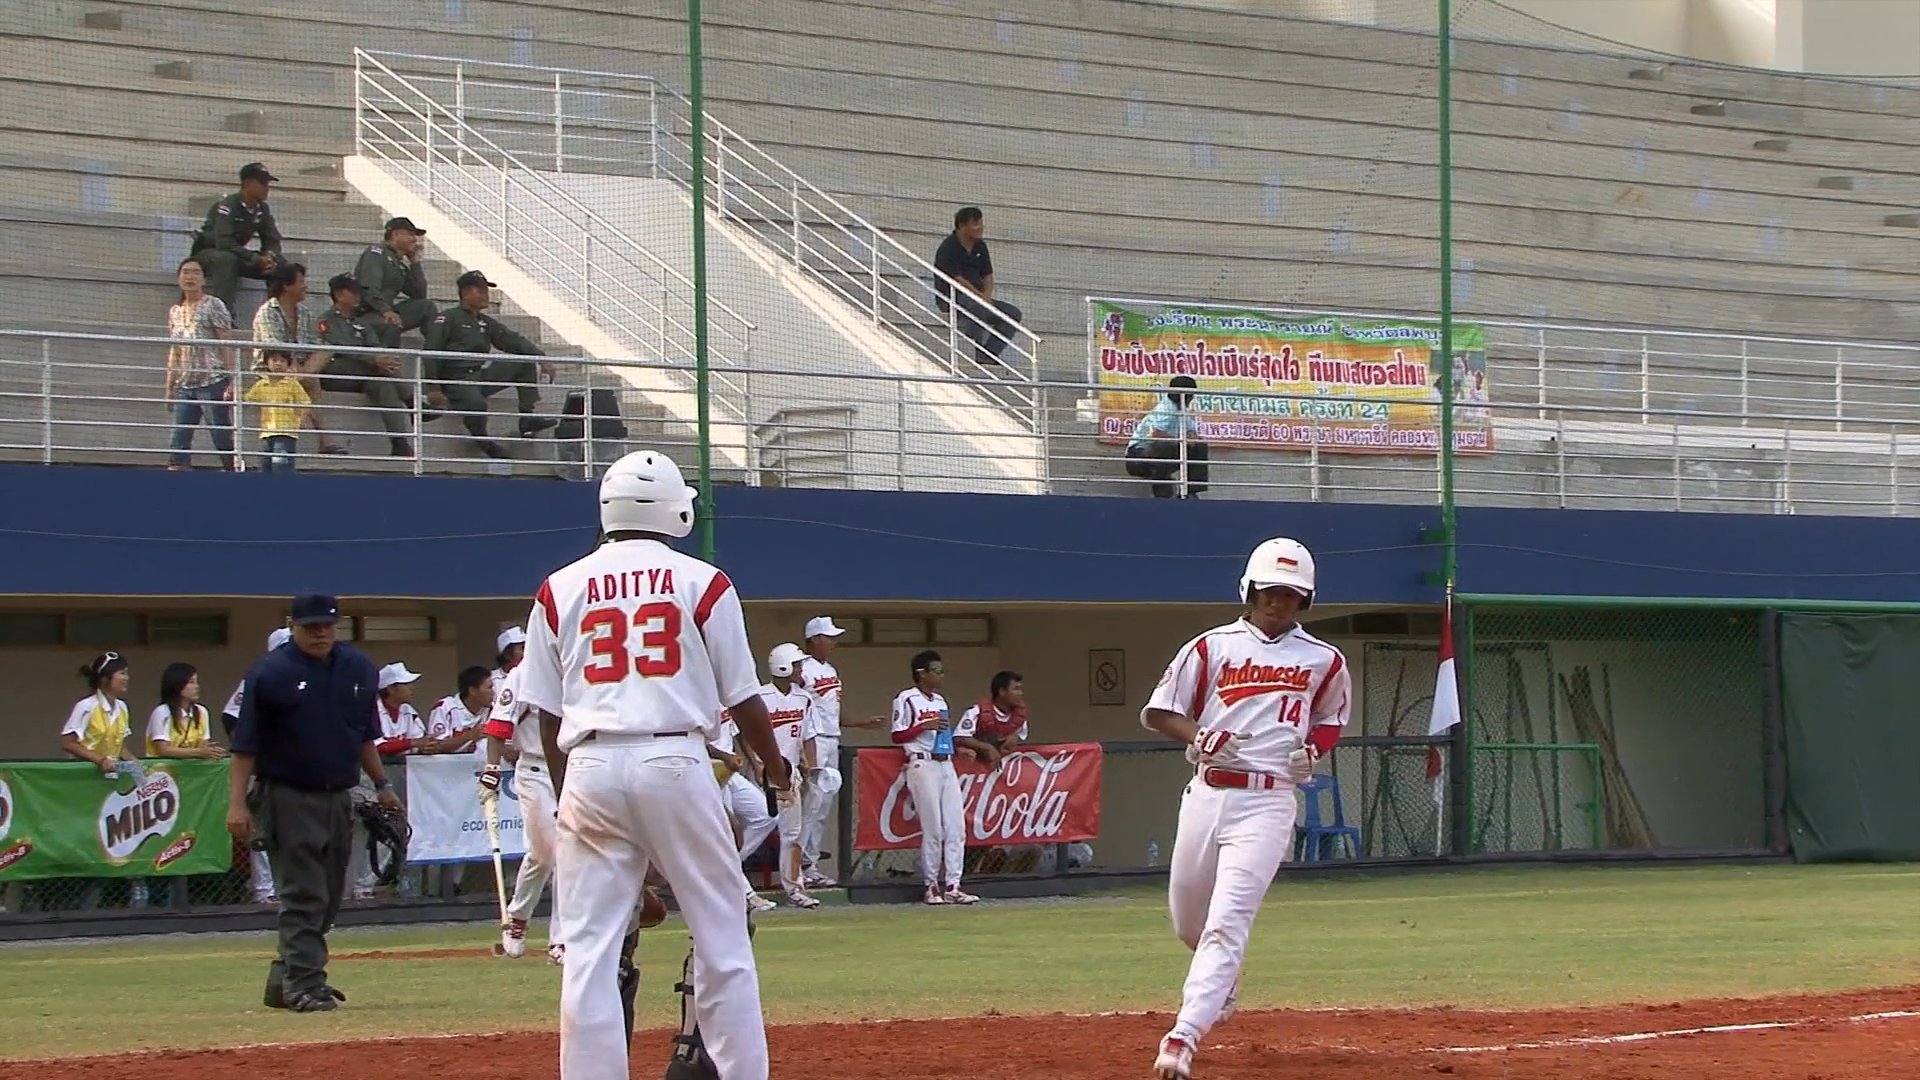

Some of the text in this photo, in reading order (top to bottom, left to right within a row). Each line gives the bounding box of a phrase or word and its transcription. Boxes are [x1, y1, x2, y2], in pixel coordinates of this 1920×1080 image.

[1360, 402, 1390, 418] 24
[1272, 424, 1290, 440] 60
[587, 568, 675, 604] ADITYA
[580, 601, 682, 686] 33
[1217, 657, 1312, 689] Indonesia
[1277, 695, 1303, 727] 14
[880, 749, 1077, 843] Ca-Cola
[106, 790, 177, 849] MILO
